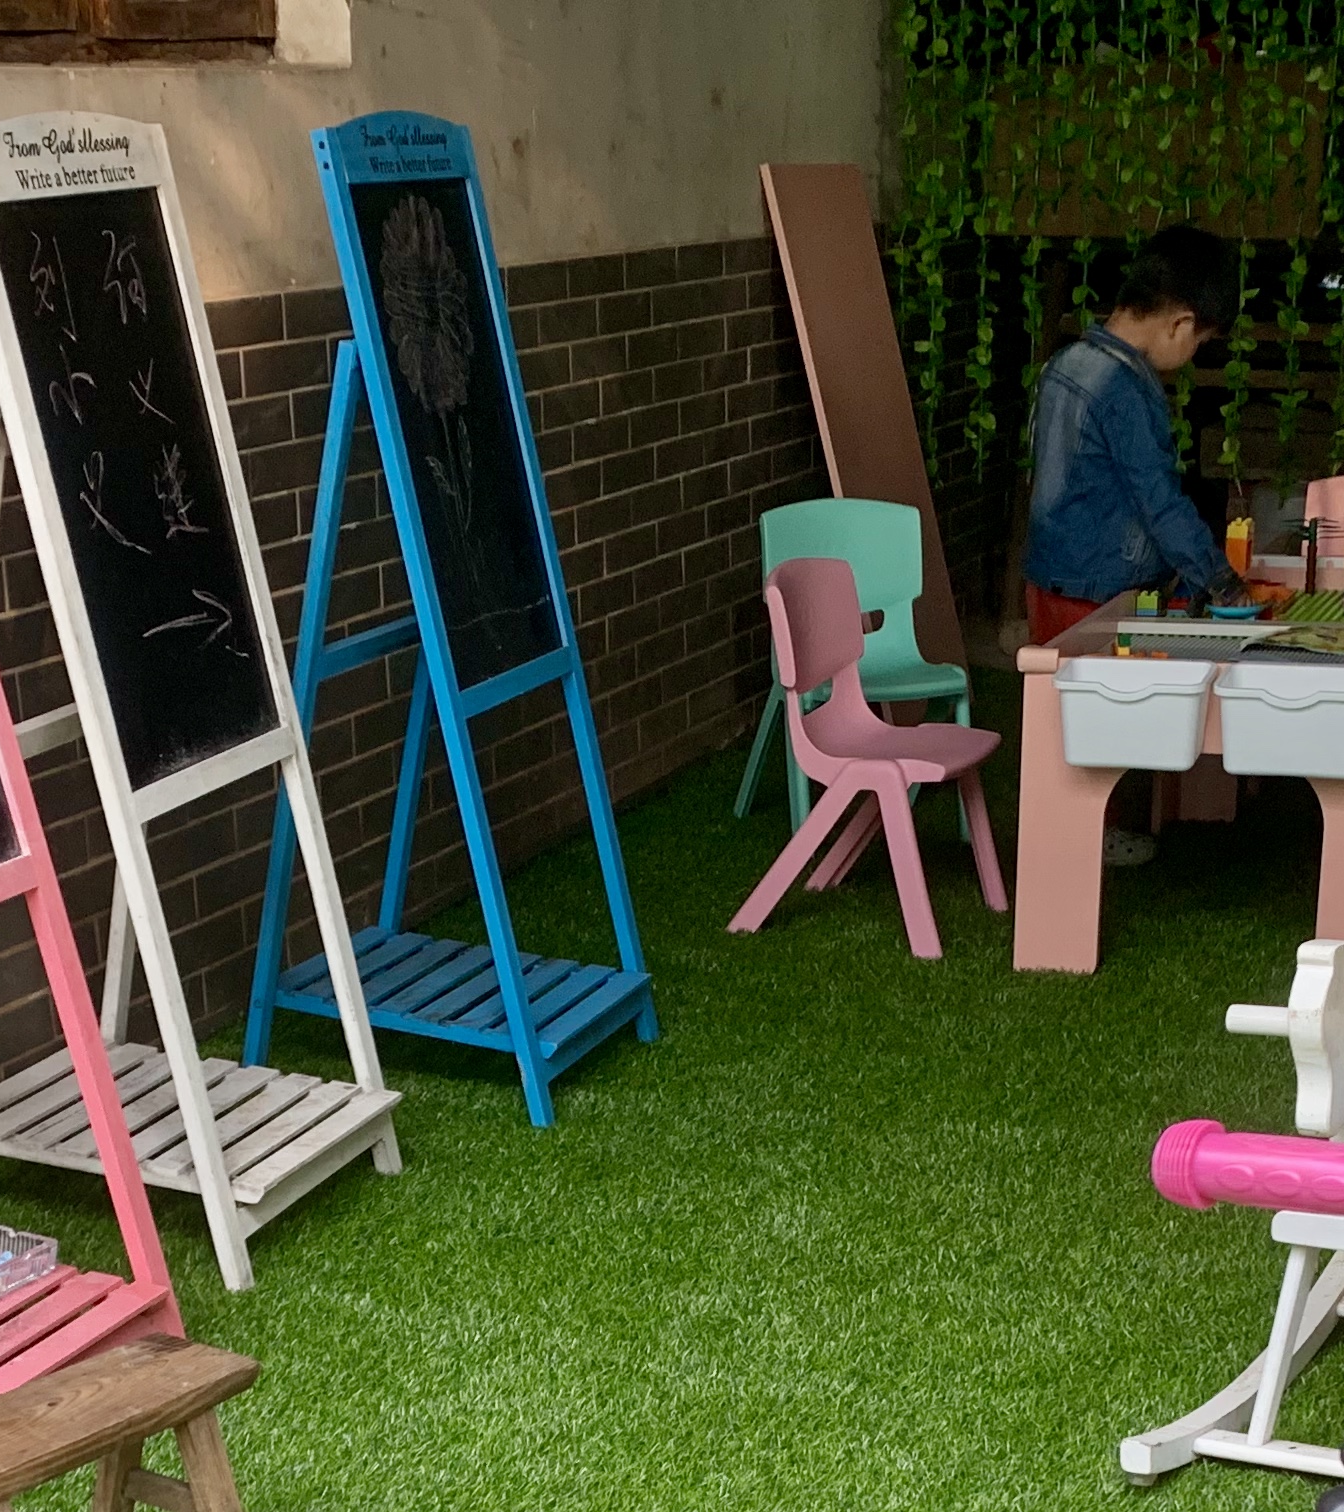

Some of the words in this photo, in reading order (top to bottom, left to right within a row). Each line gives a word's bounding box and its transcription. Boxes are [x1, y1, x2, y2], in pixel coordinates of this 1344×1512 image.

[3, 131, 41, 158] From
[15, 168, 52, 191] Write
[55, 172, 63, 187] a
[62, 166, 98, 187] better
[99, 164, 136, 183] future
[369, 156, 395, 174] Write
[400, 155, 427, 173] better
[427, 154, 452, 172] future
